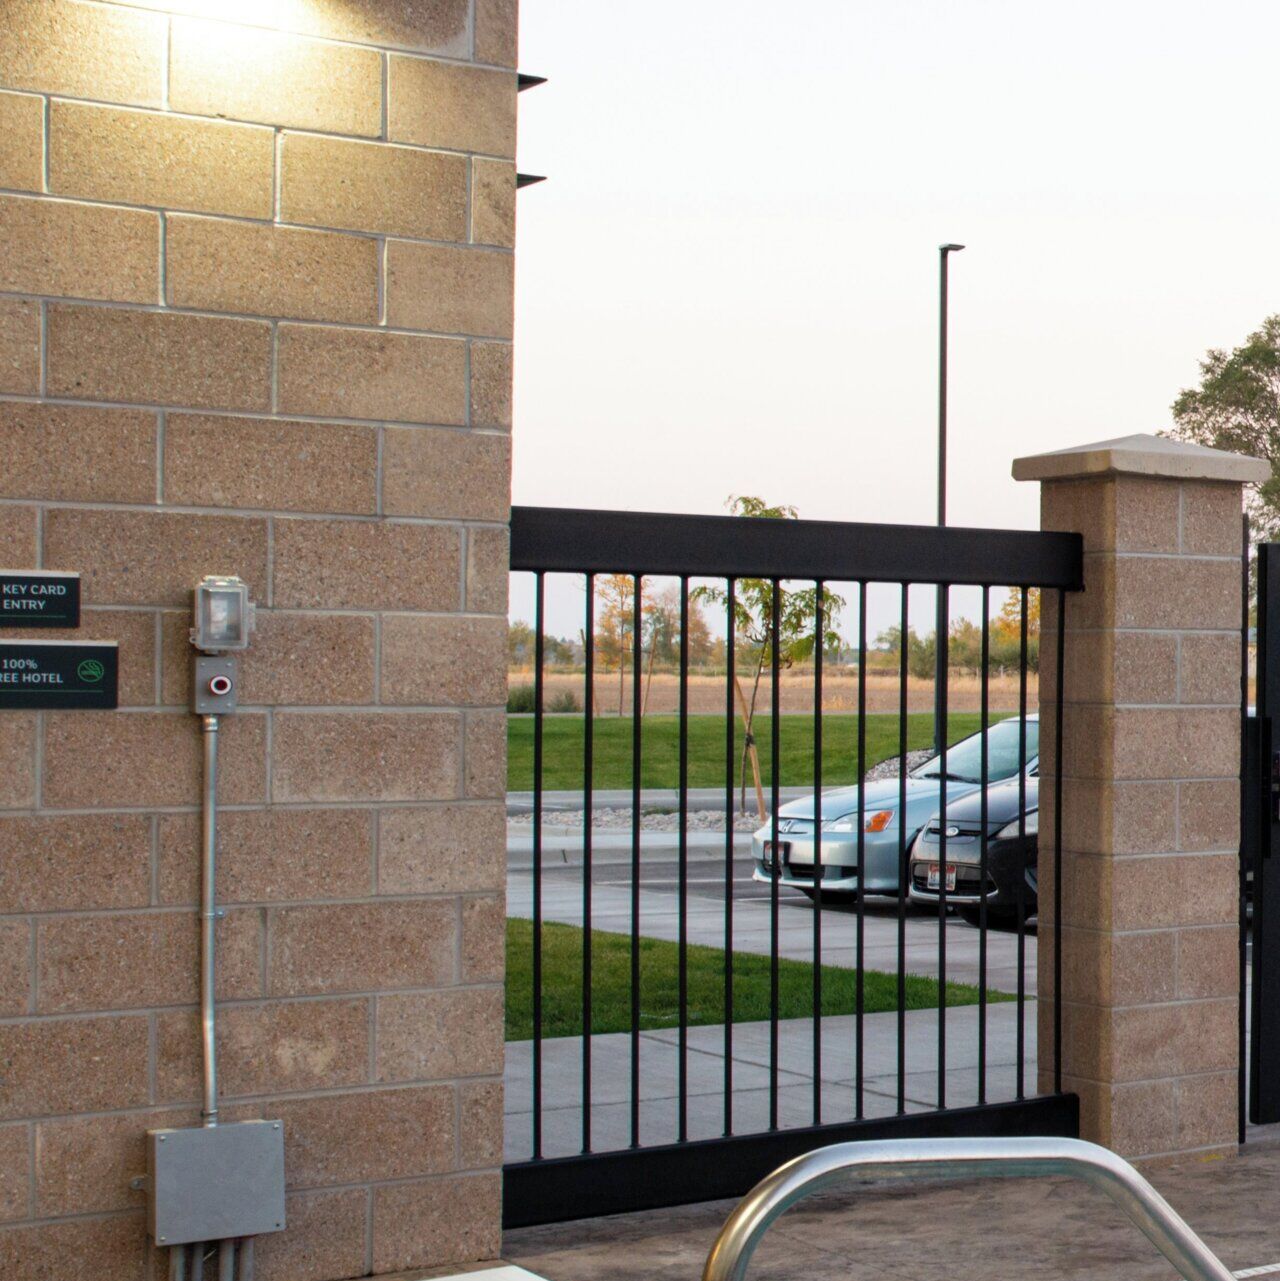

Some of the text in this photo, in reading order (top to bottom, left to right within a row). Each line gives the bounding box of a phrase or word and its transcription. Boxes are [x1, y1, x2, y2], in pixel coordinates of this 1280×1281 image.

[2, 584, 66, 595] KEY CARD
[3, 600, 45, 610] ENTRY
[2, 659, 38, 670] 100%
[22, 673, 63, 683] HOTEL
